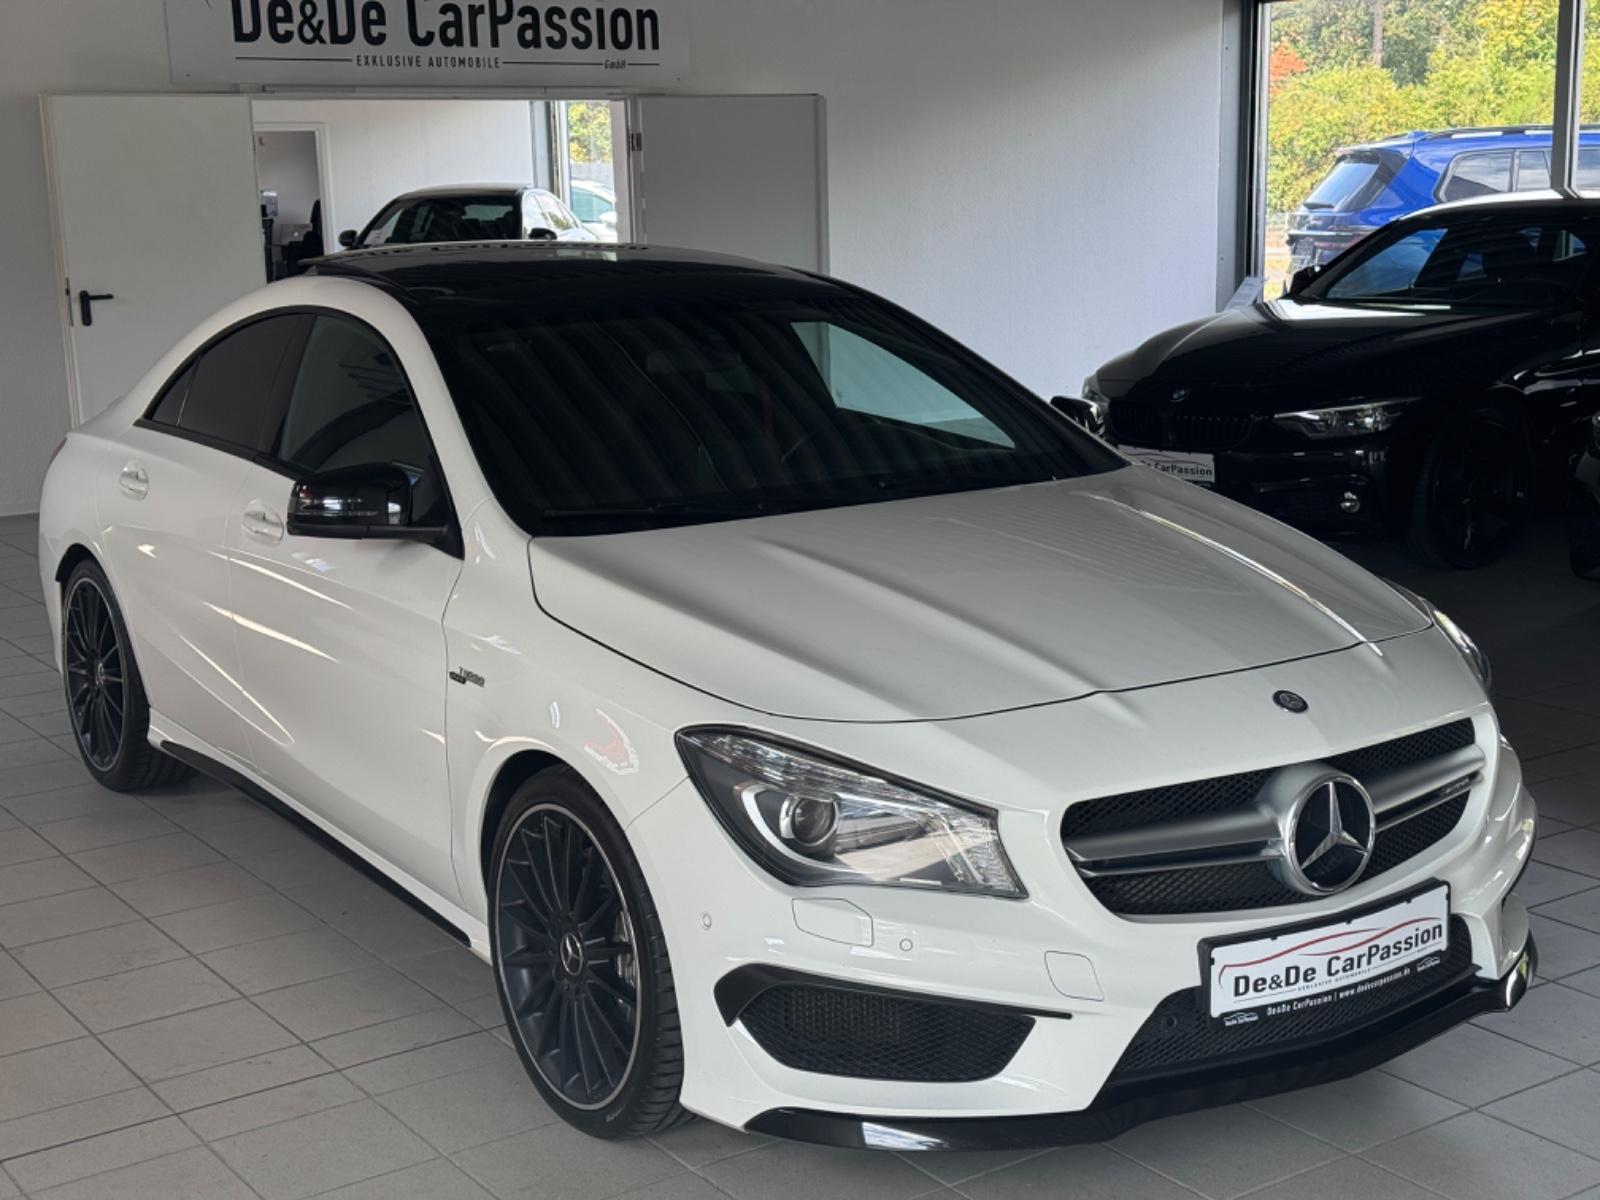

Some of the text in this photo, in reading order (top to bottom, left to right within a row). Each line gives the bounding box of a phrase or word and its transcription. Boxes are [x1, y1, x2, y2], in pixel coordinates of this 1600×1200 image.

[231, 0, 660, 51] De&De CarPassion
[356, 54, 422, 68] EXKLUSIVE
[427, 55, 501, 69] AUTOMOBILE
[1154, 462, 1212, 476] CarPassion
[1233, 923, 1443, 998] De&De CarPassion
